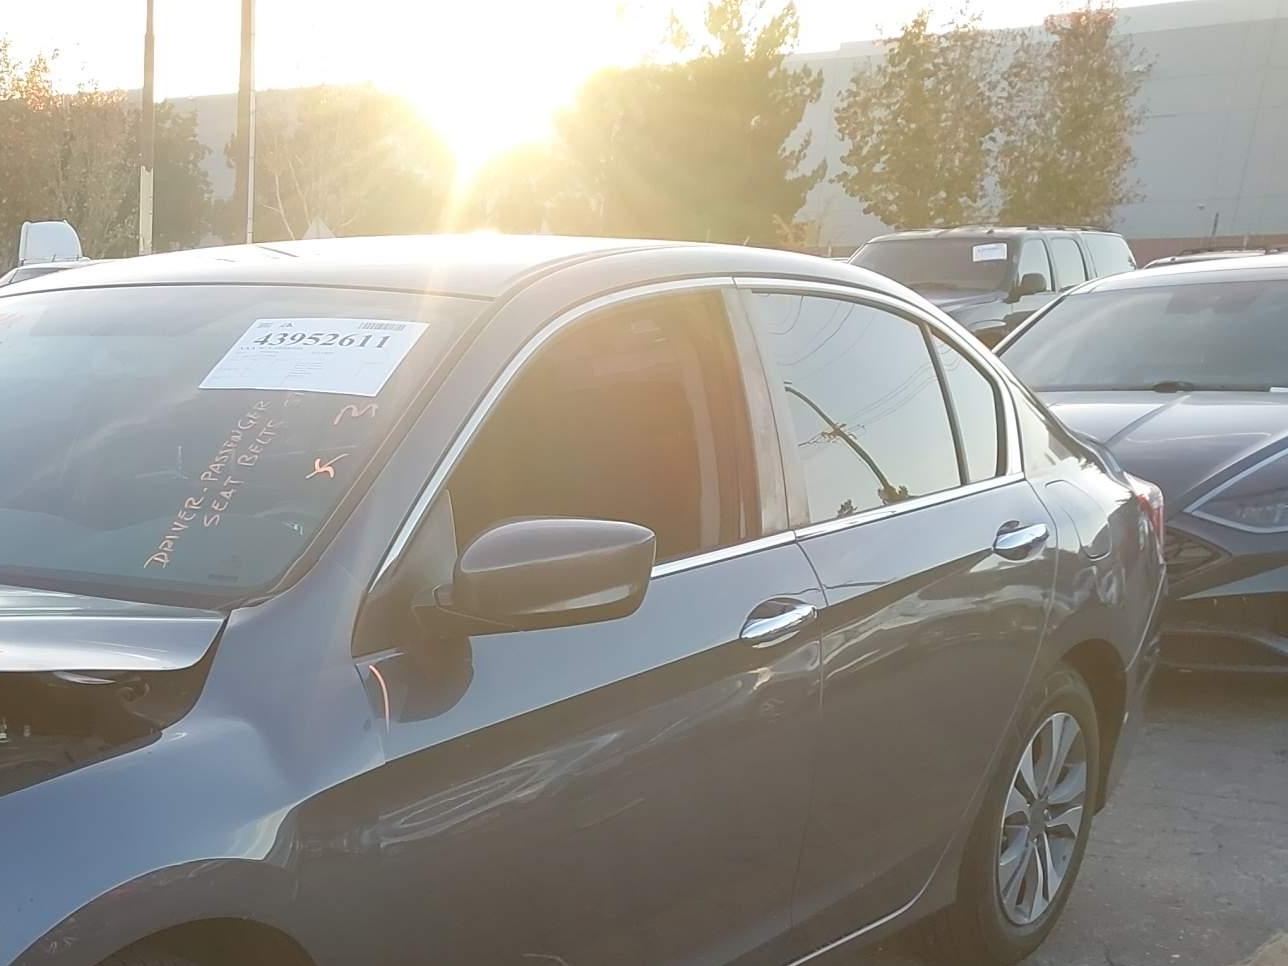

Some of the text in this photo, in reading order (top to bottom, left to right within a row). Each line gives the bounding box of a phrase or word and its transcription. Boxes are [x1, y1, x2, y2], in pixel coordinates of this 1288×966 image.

[253, 332, 392, 349] 43952611
[203, 476, 245, 528] SEAT
[143, 496, 203, 569] DRIVER
